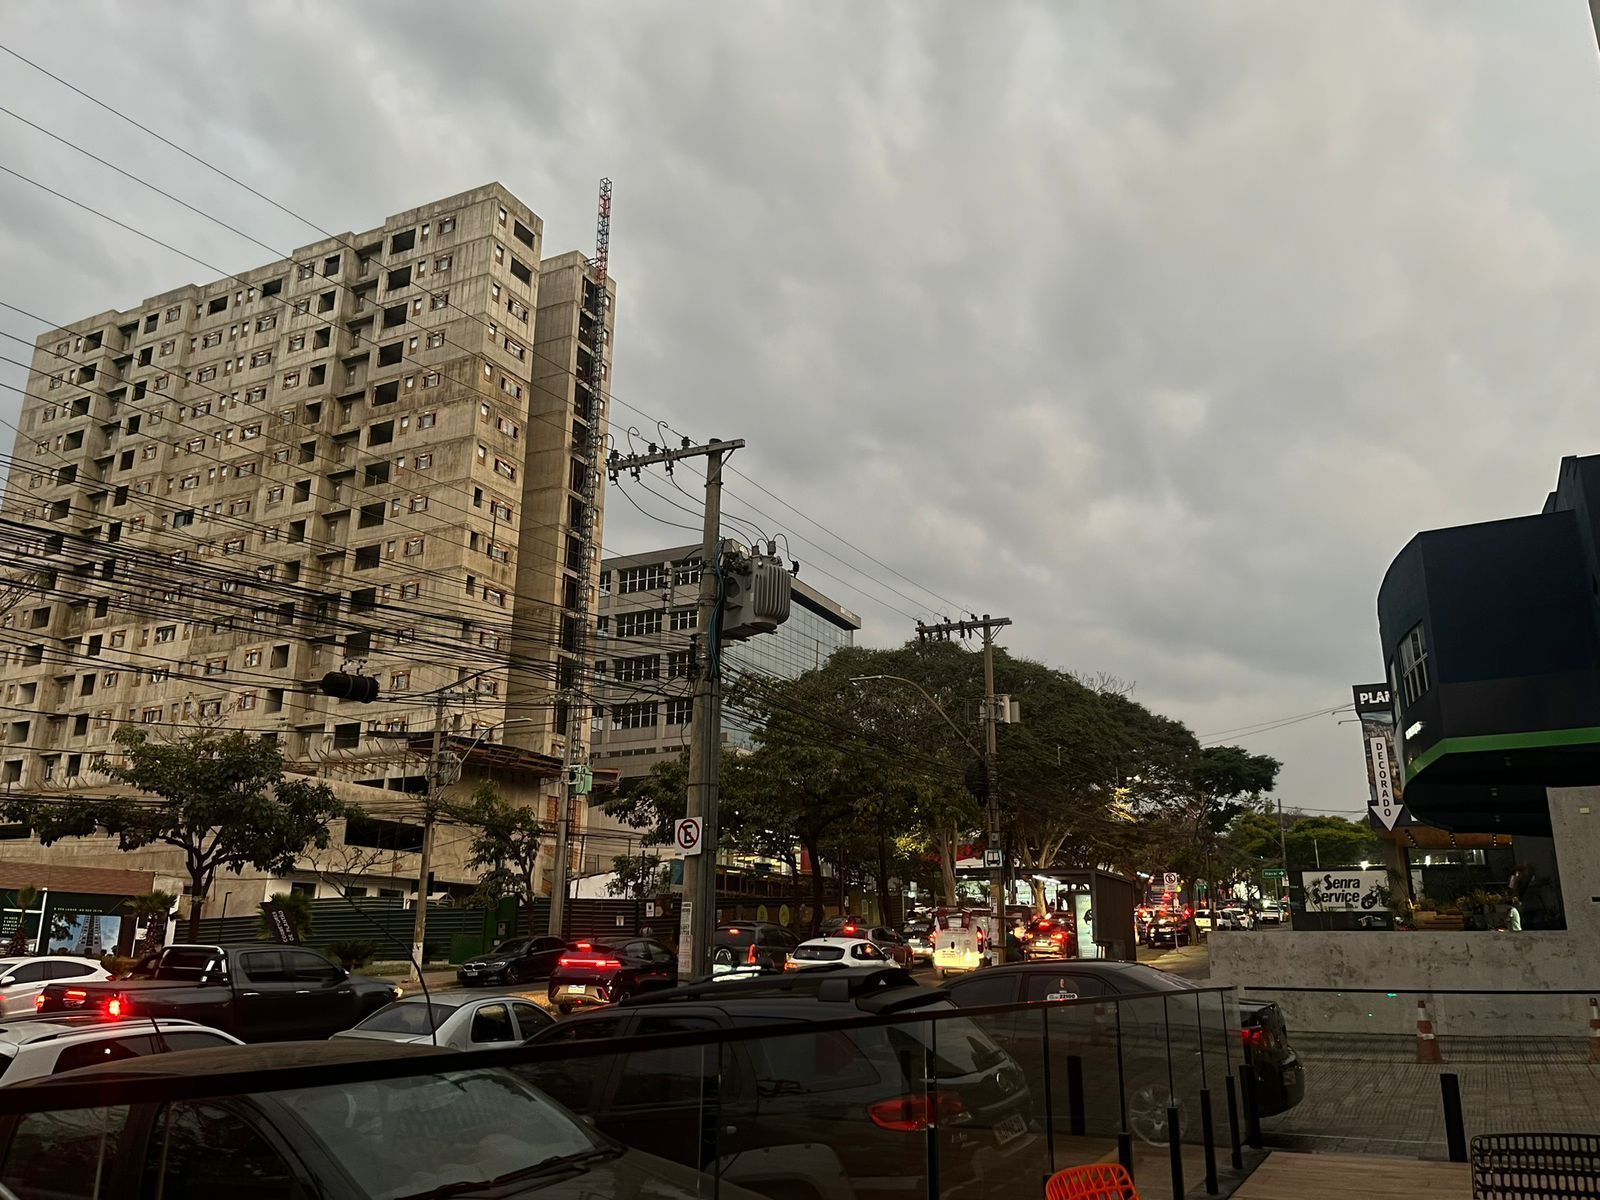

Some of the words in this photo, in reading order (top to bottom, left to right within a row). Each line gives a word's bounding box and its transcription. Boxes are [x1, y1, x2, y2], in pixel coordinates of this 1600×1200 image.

[1375, 742, 1392, 817] DECORADO
[1323, 874, 1361, 890] Senra
[1312, 888, 1360, 904] Service
